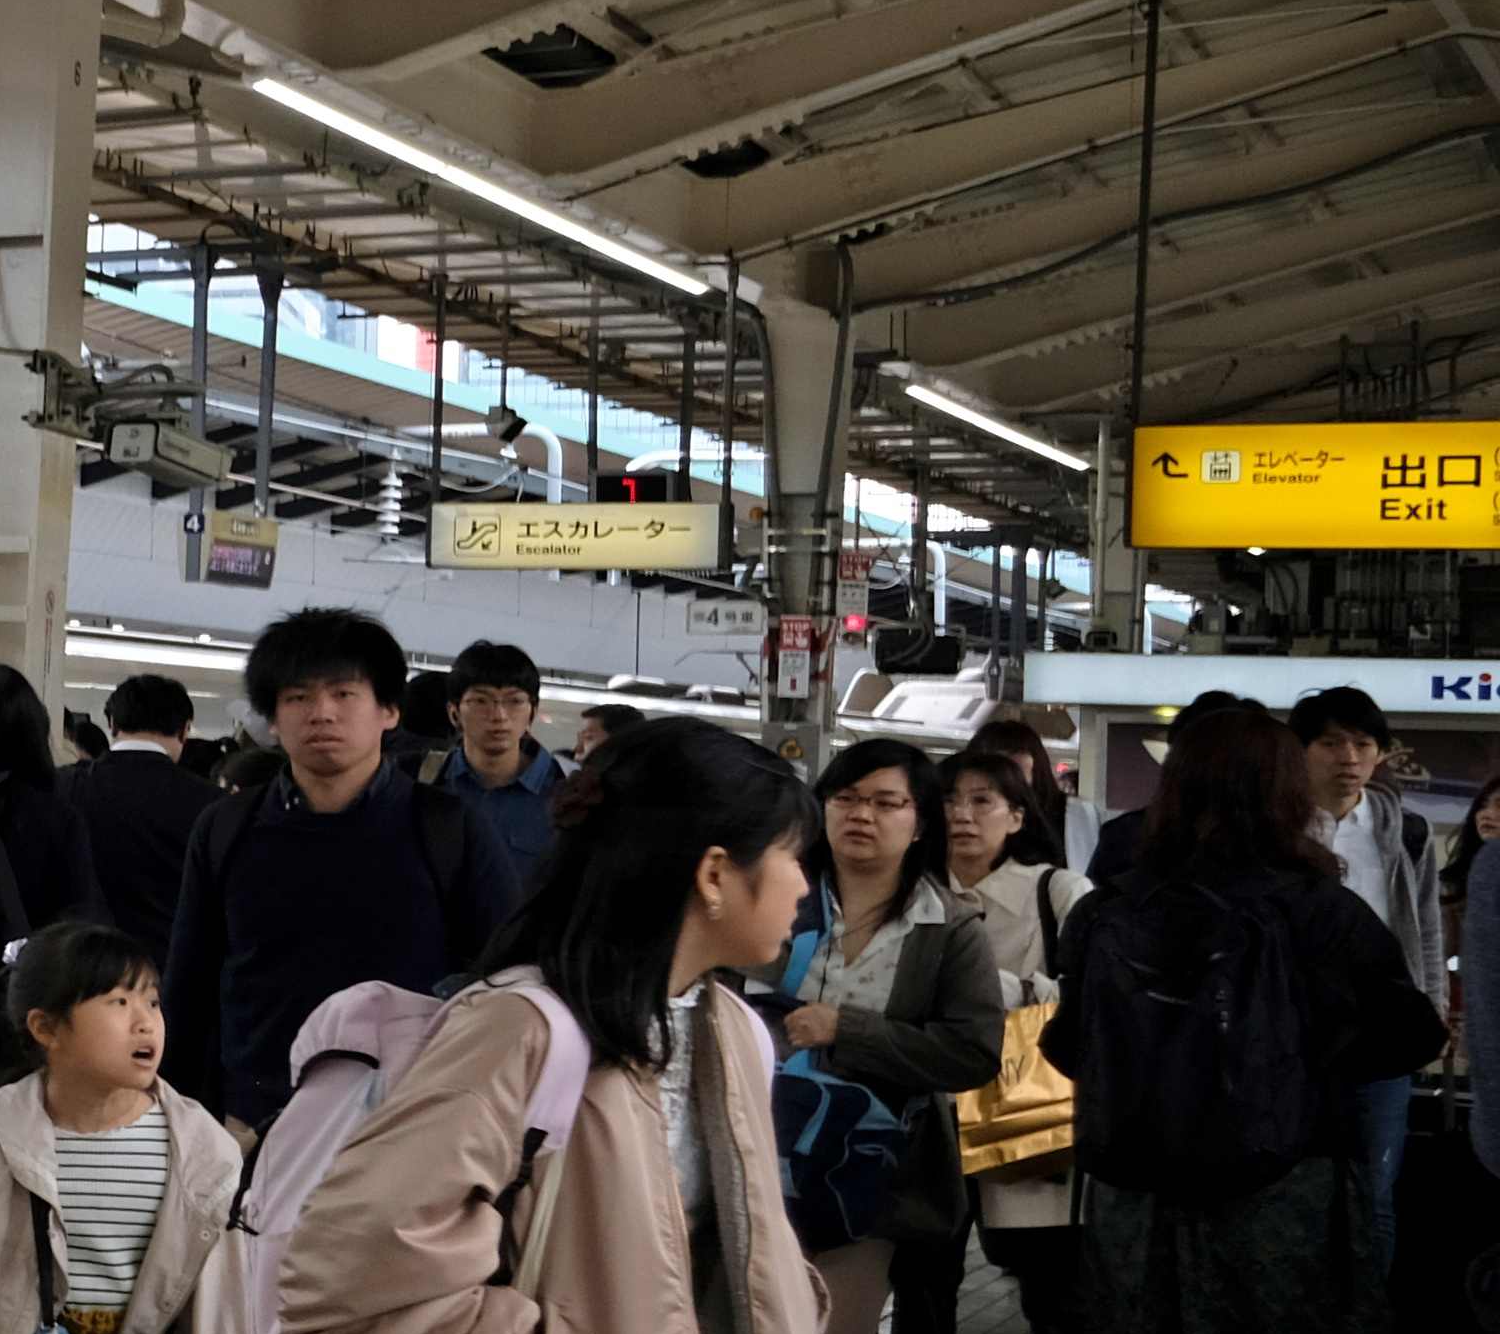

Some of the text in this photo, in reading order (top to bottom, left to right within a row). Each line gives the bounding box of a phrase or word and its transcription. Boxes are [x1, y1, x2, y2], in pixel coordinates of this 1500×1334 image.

[1253, 450, 1345, 469] エレベーター
[1253, 473, 1321, 484] Elevator
[1381, 454, 1482, 489] 出口
[1380, 498, 1448, 521] Exit
[186, 515, 200, 532] 4
[516, 520, 691, 540] エスカレーター
[516, 544, 582, 556] Escalator
[1431, 672, 1500, 701] Ki
